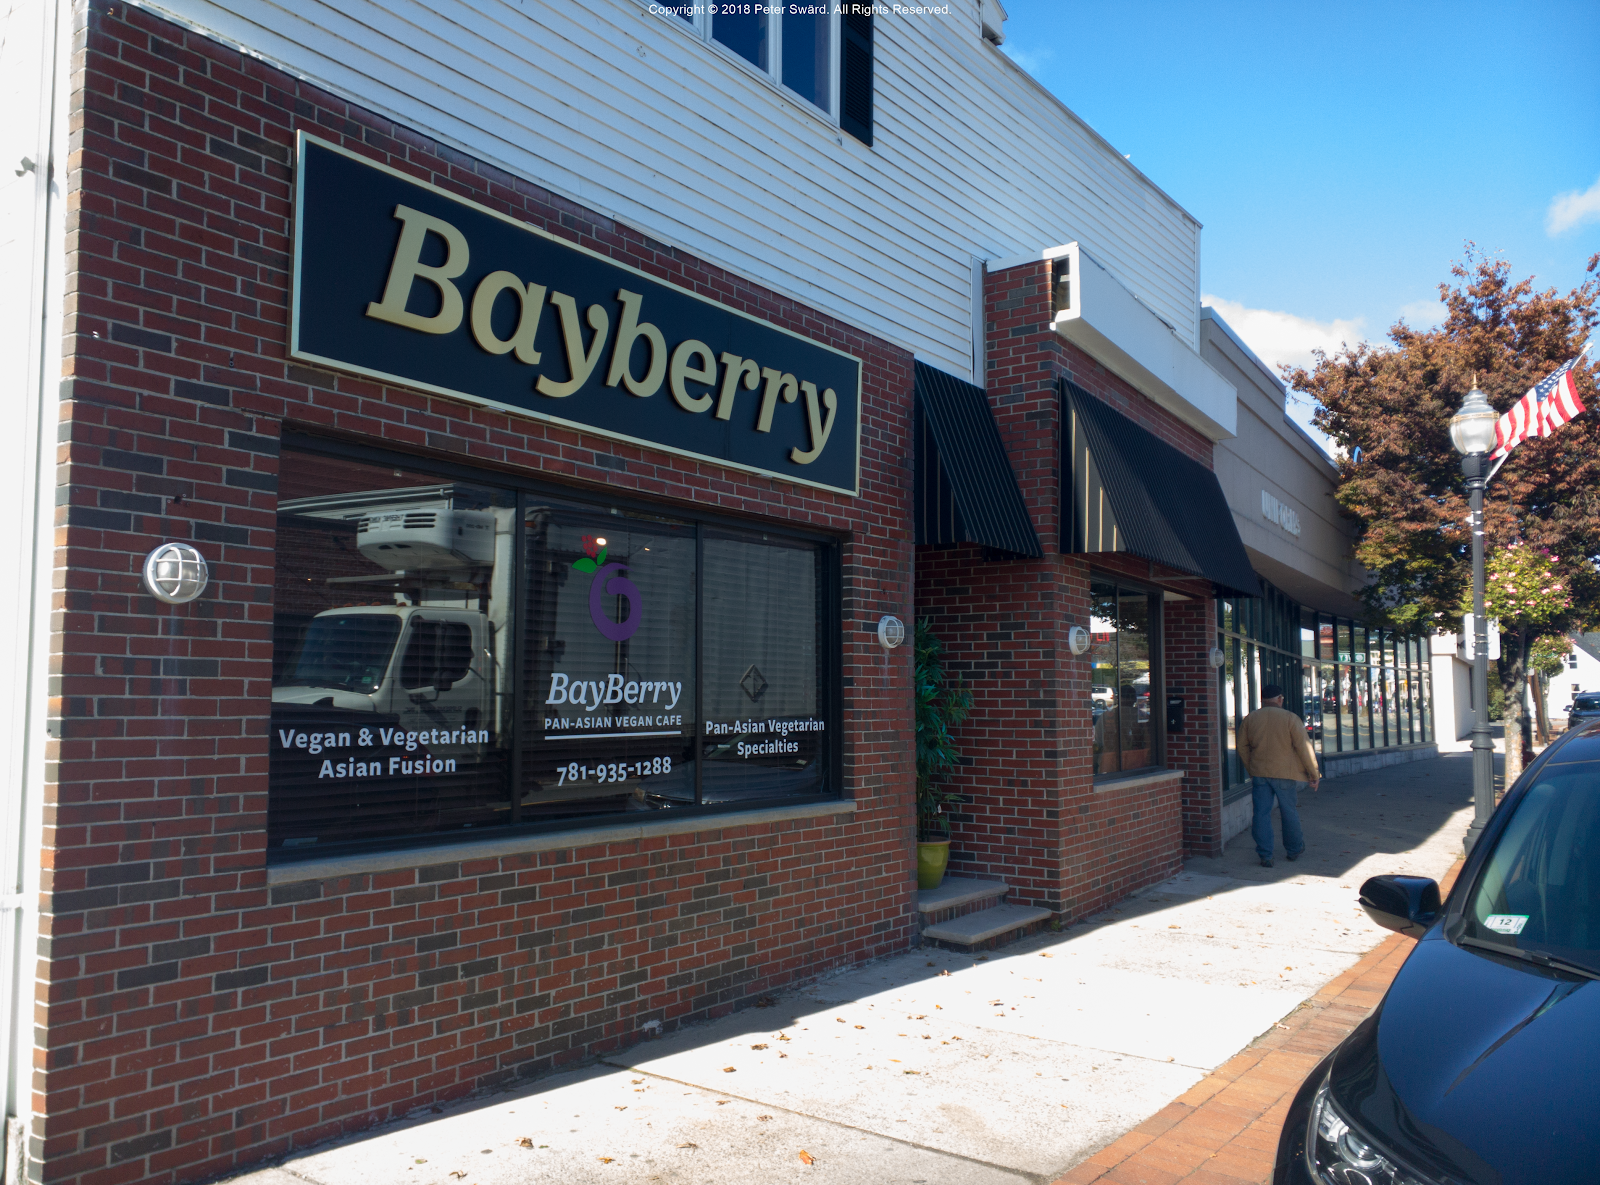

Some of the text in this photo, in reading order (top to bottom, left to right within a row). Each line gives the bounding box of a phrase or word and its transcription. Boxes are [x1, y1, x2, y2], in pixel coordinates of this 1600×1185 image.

[365, 203, 838, 466] Bayberry
[545, 672, 682, 712] BayBerry
[544, 714, 682, 730] PAN-ASIAN VEGAN CAFE
[705, 717, 825, 737] Pan-Asian Vegetarian
[278, 725, 489, 754] Vegan & Vegetarian
[737, 738, 799, 759] Specialties
[318, 754, 456, 779] Asian Fusion
[556, 756, 672, 787] 781-935-1288
